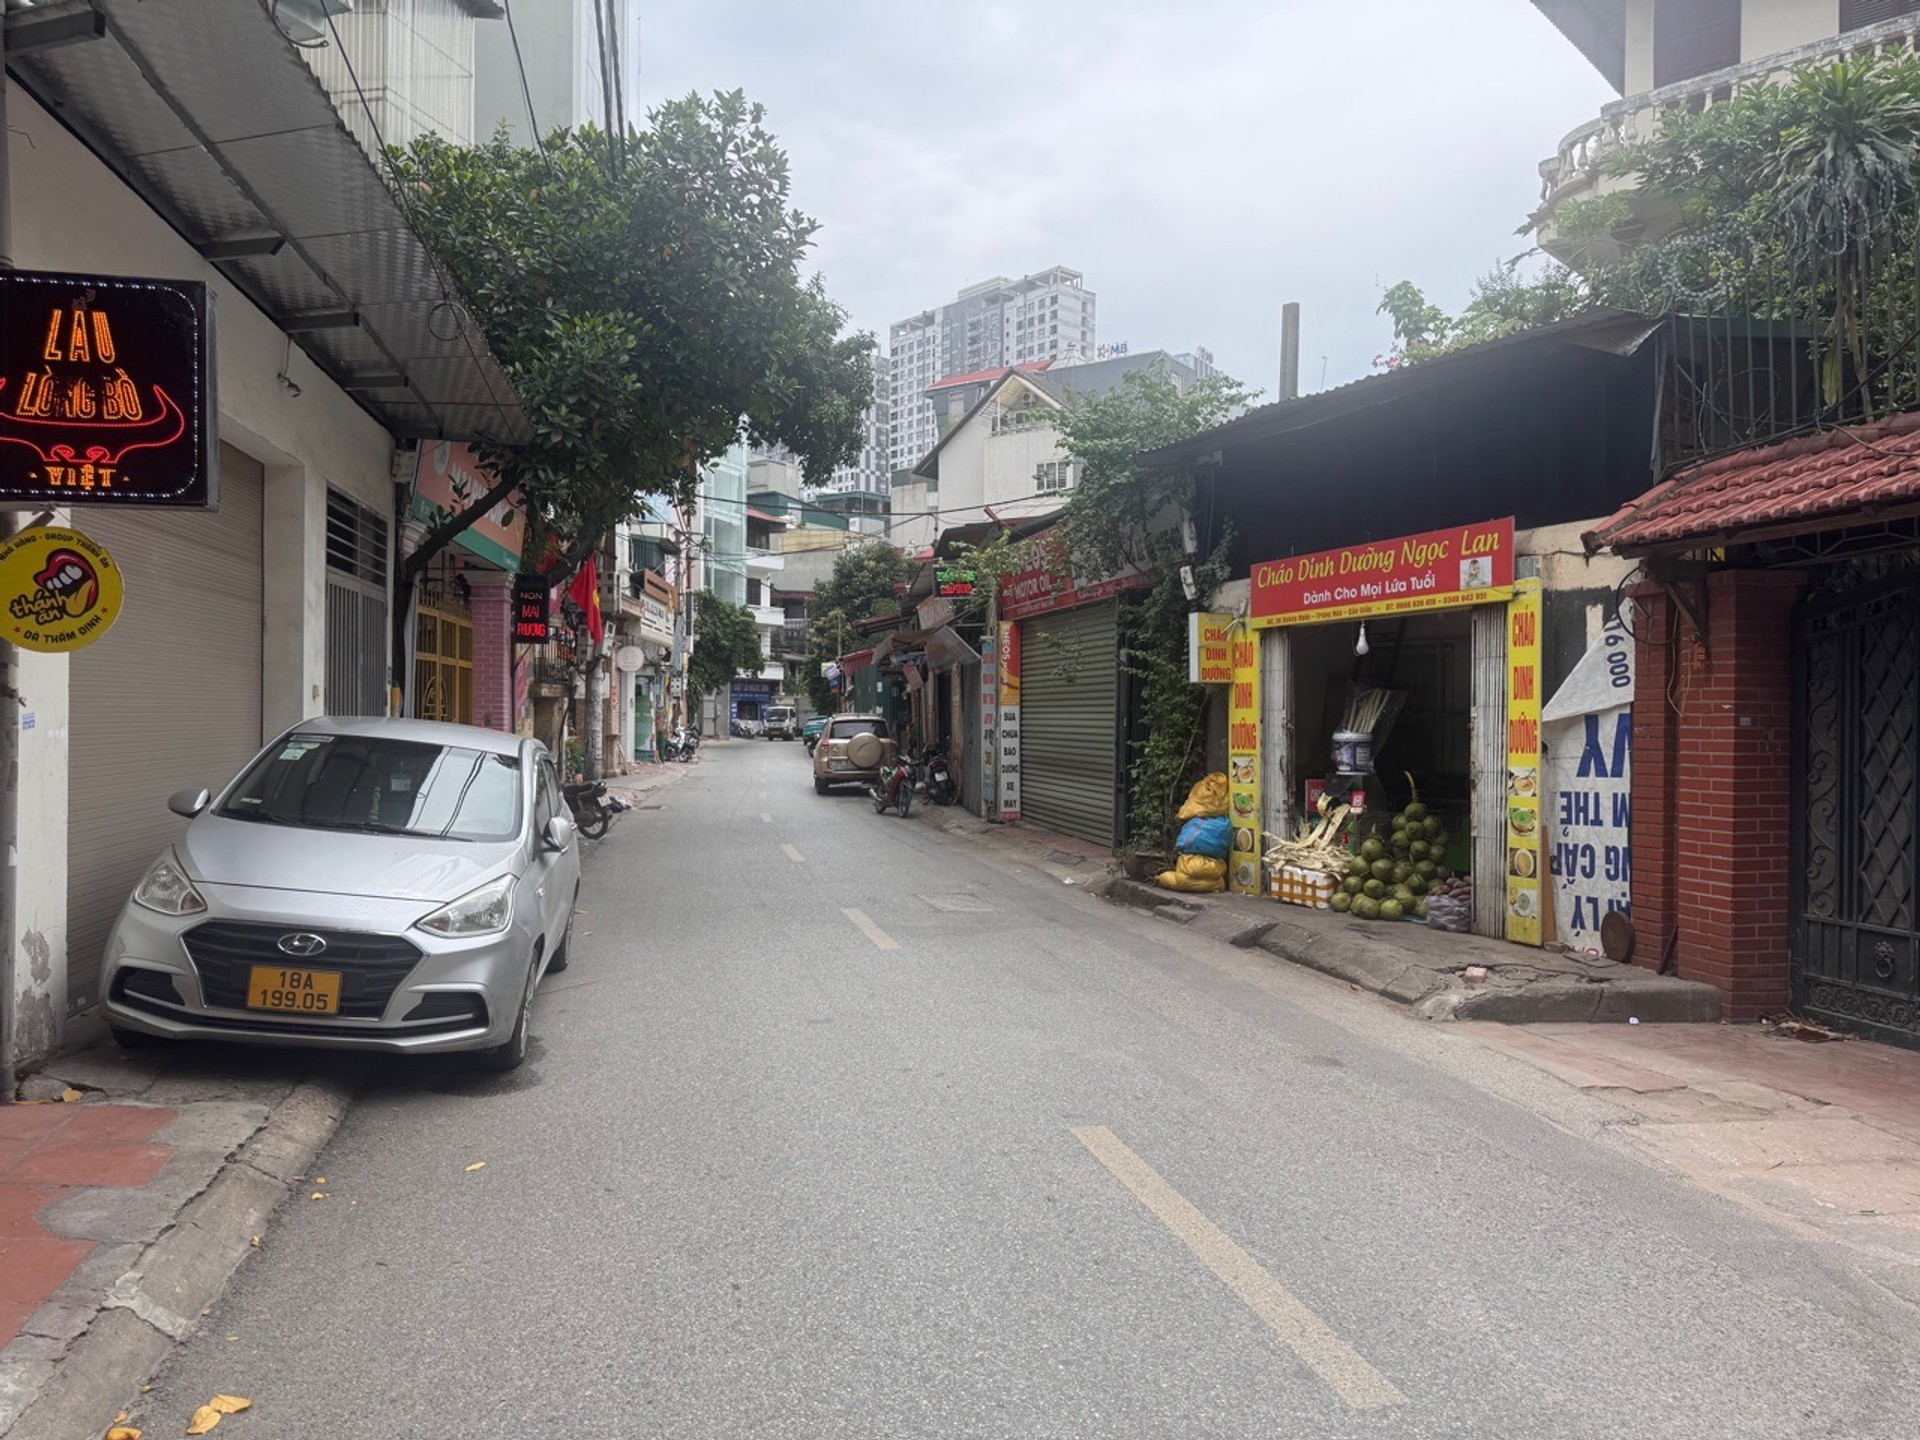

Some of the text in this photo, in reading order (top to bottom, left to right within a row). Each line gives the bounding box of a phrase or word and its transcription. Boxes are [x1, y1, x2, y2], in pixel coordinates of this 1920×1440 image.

[45, 463, 117, 490] VIỆT
[45, 532, 74, 542] GROUP
[1257, 563, 1294, 588] Cháo
[1340, 547, 1395, 573] Dưỡng
[1401, 539, 1449, 568] Ngọc
[1461, 530, 1500, 555] Lan
[1014, 578, 1038, 599] MOTOR
[1303, 589, 1331, 605] Dành
[1334, 586, 1357, 600] Cho
[1360, 581, 1381, 599] Mọi
[1410, 570, 1435, 589] Tuổi
[522, 605, 540, 618] MAI
[1512, 604, 1535, 648] CHÁO
[1001, 623, 1011, 660] ENEOS
[1204, 625, 1228, 641] CHÁO
[1206, 648, 1227, 661] DINH
[1234, 637, 1254, 668] CHÁO
[1201, 664, 1232, 680] DƯỠNG
[1513, 665, 1534, 700] DINH
[1606, 650, 1632, 688] 000
[1234, 683, 1253, 709] DINH
[1231, 717, 1257, 750] DƯỠNG
[1509, 711, 1538, 754] DƯỠNG
[1006, 782, 1014, 791] XE
[1559, 791, 1603, 837] THẺ
[1550, 843, 1596, 889] CẤP
[1570, 895, 1600, 937] LÝ
[278, 970, 314, 990] 18A
[260, 988, 329, 1011] 199.05
